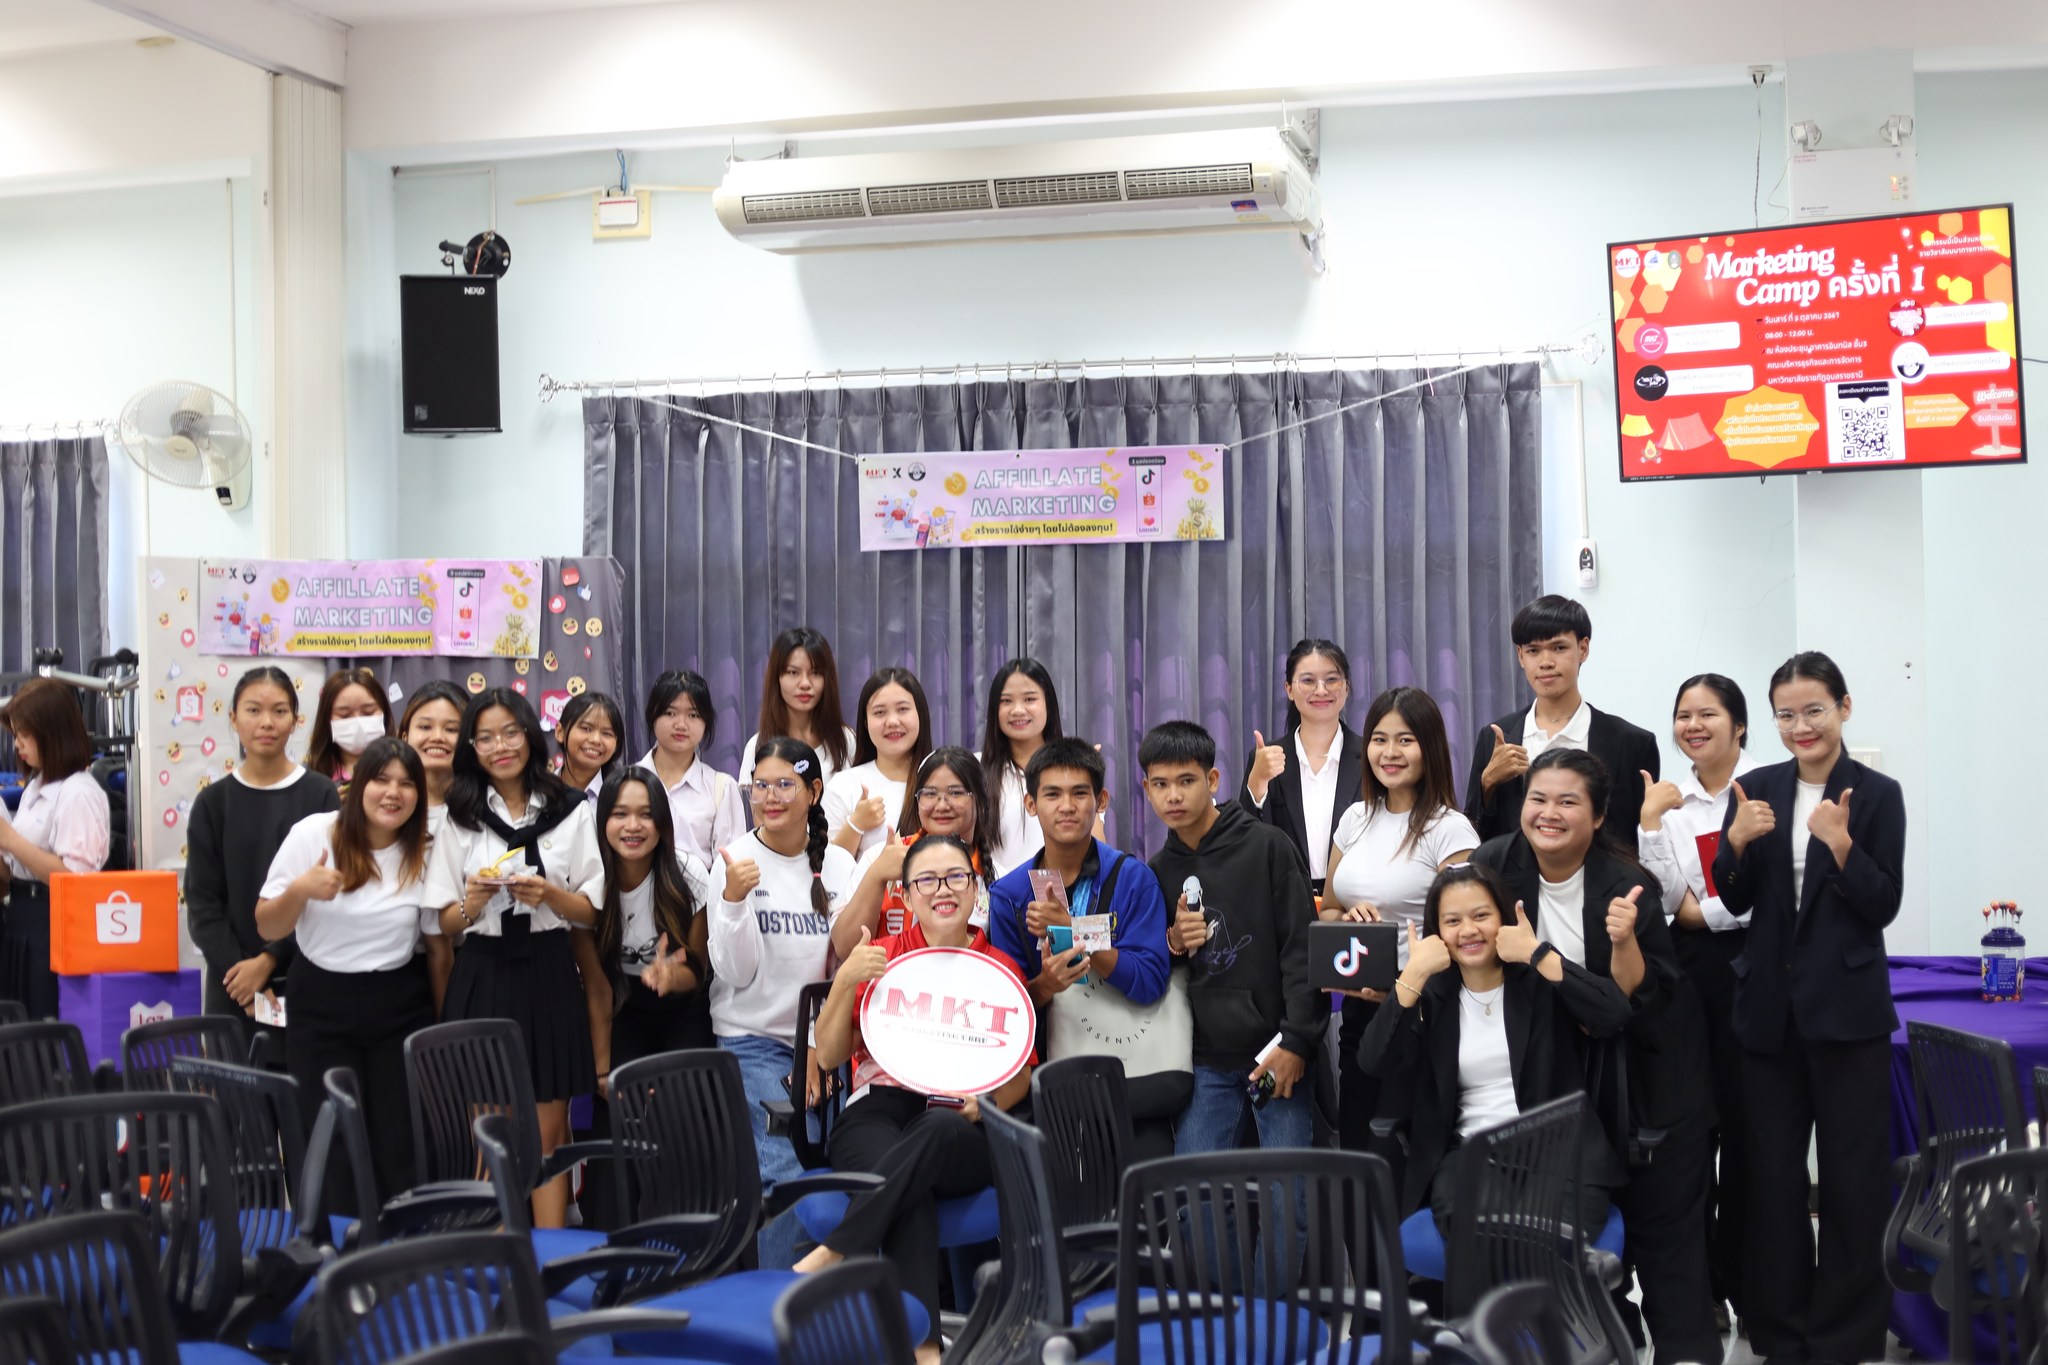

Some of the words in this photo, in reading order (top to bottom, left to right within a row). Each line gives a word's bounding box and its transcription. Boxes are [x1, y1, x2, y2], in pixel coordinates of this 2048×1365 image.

[1704, 244, 1835, 280] Marketing
[1736, 278, 1820, 307] Camp
[1828, 254, 1901, 298] ครั้งที่
[1911, 266, 1925, 292] 1
[1977, 389, 2015, 402] Welcome
[974, 466, 1102, 489] AFFILLATE
[971, 494, 1116, 517] MARKETING
[296, 576, 420, 598] AFFILLATE
[294, 606, 433, 627] MARKETING
[110, 909, 128, 936] S
[879, 987, 1019, 1035] MKT
